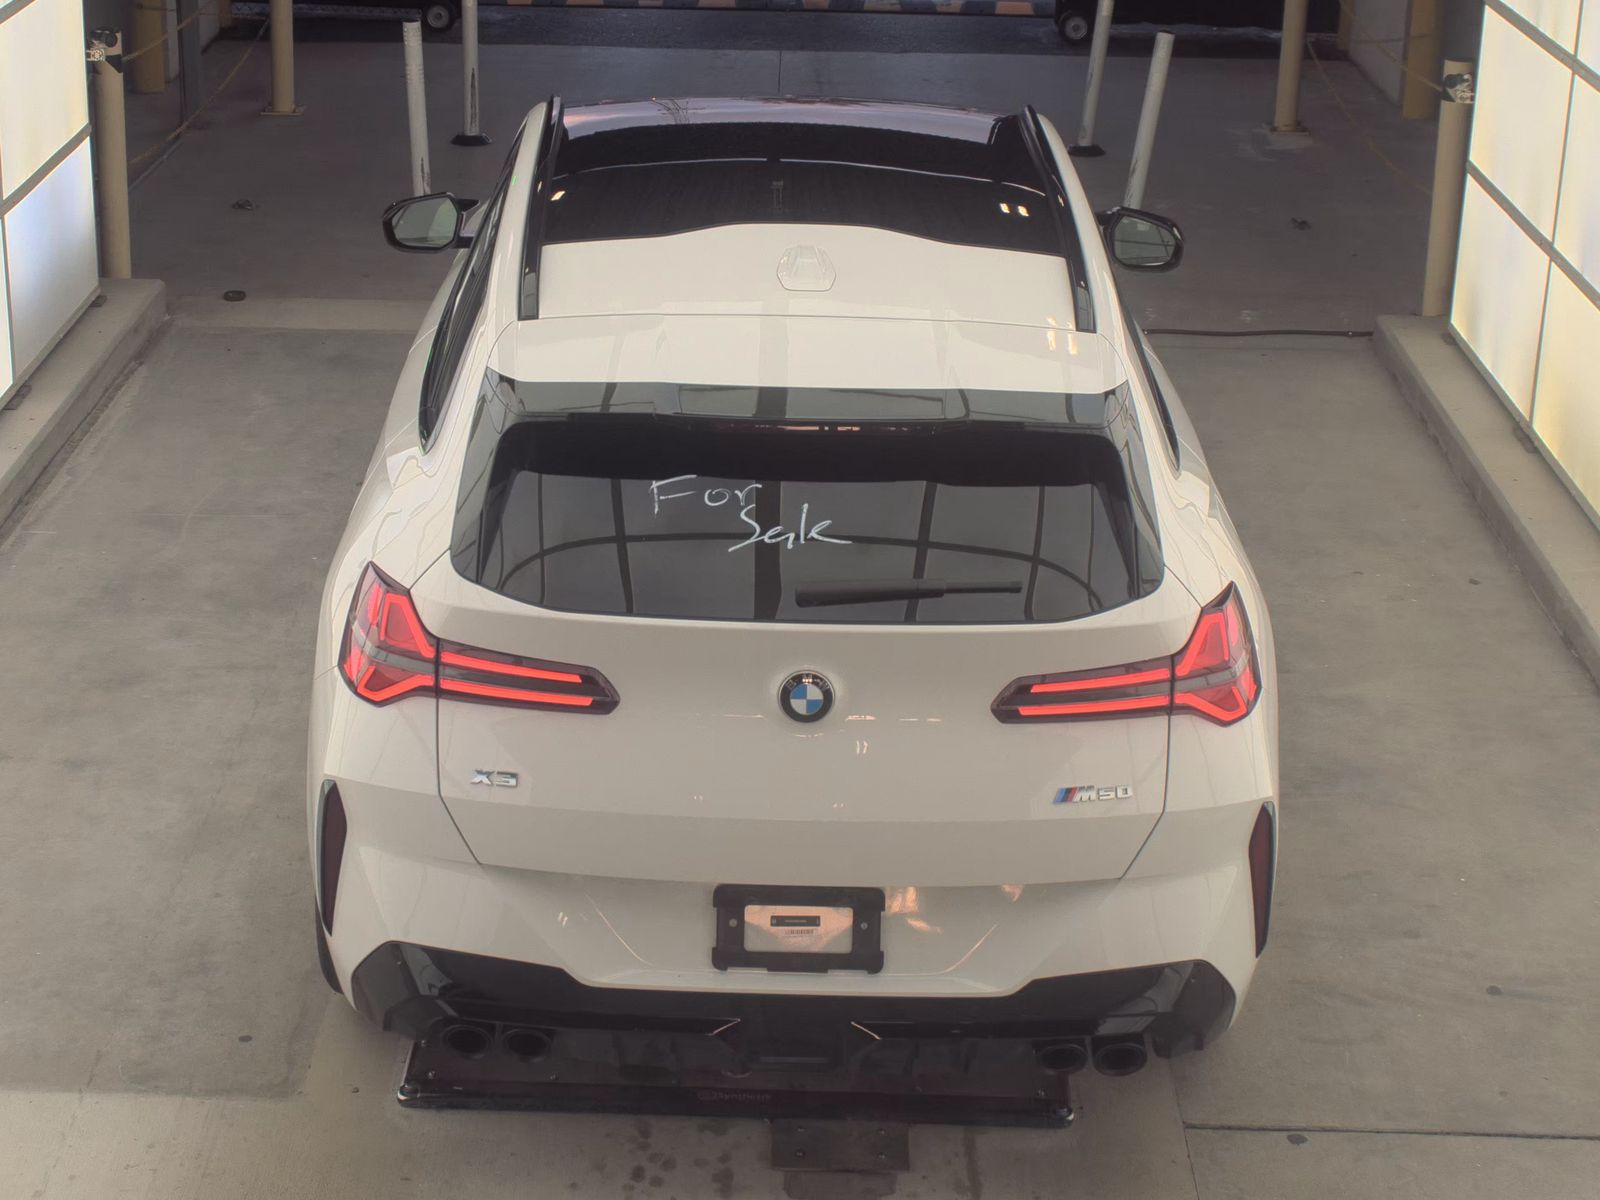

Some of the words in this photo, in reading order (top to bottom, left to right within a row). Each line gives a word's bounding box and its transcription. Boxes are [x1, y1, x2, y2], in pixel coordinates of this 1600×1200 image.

[649, 474, 763, 517] For
[727, 503, 854, 553] Sale
[470, 769, 519, 788] X3
[1071, 784, 1133, 803] M50
